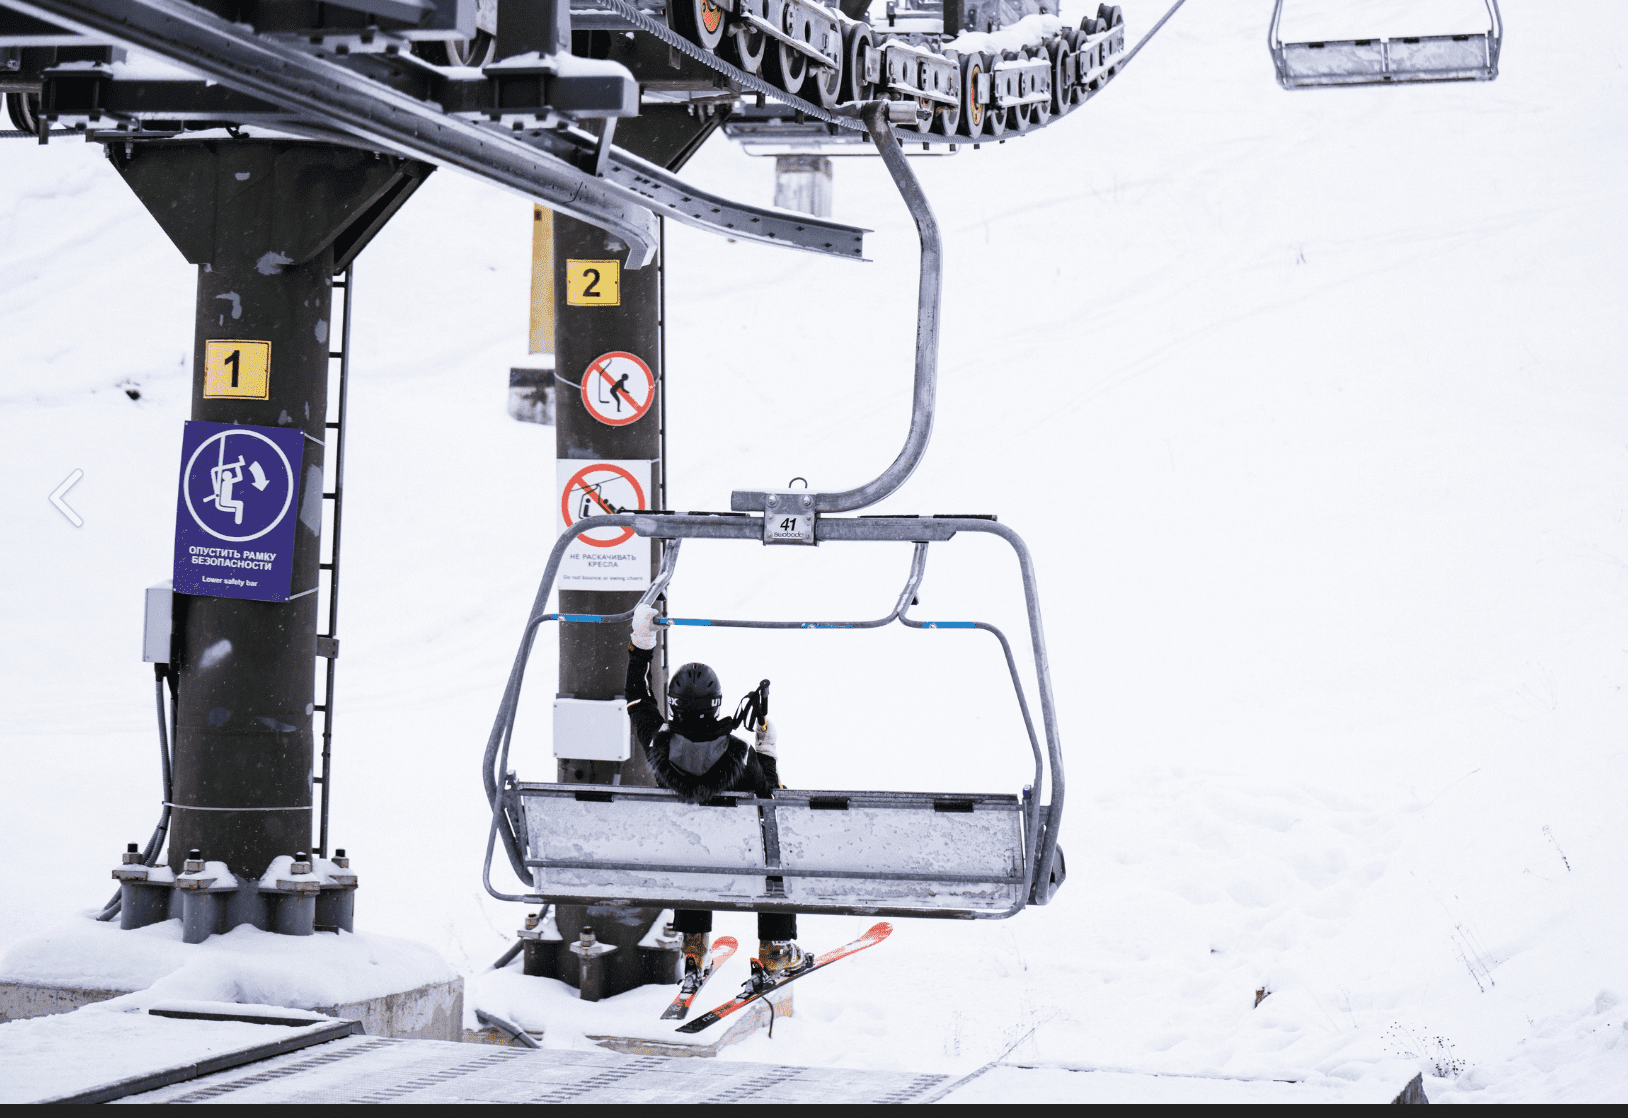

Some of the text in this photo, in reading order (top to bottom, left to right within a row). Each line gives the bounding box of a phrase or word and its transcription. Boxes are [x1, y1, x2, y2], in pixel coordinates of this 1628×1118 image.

[582, 268, 601, 297] 2
[224, 350, 240, 387] 1
[780, 517, 797, 531] 41
[188, 545, 277, 561] ОПУСТИТЬ РАМКУ
[582, 553, 637, 561] РАСКАЧИВАТЬ
[191, 555, 272, 571] БЕЗОПАСНОСТИ
[201, 575, 258, 587] Lower safety bar
